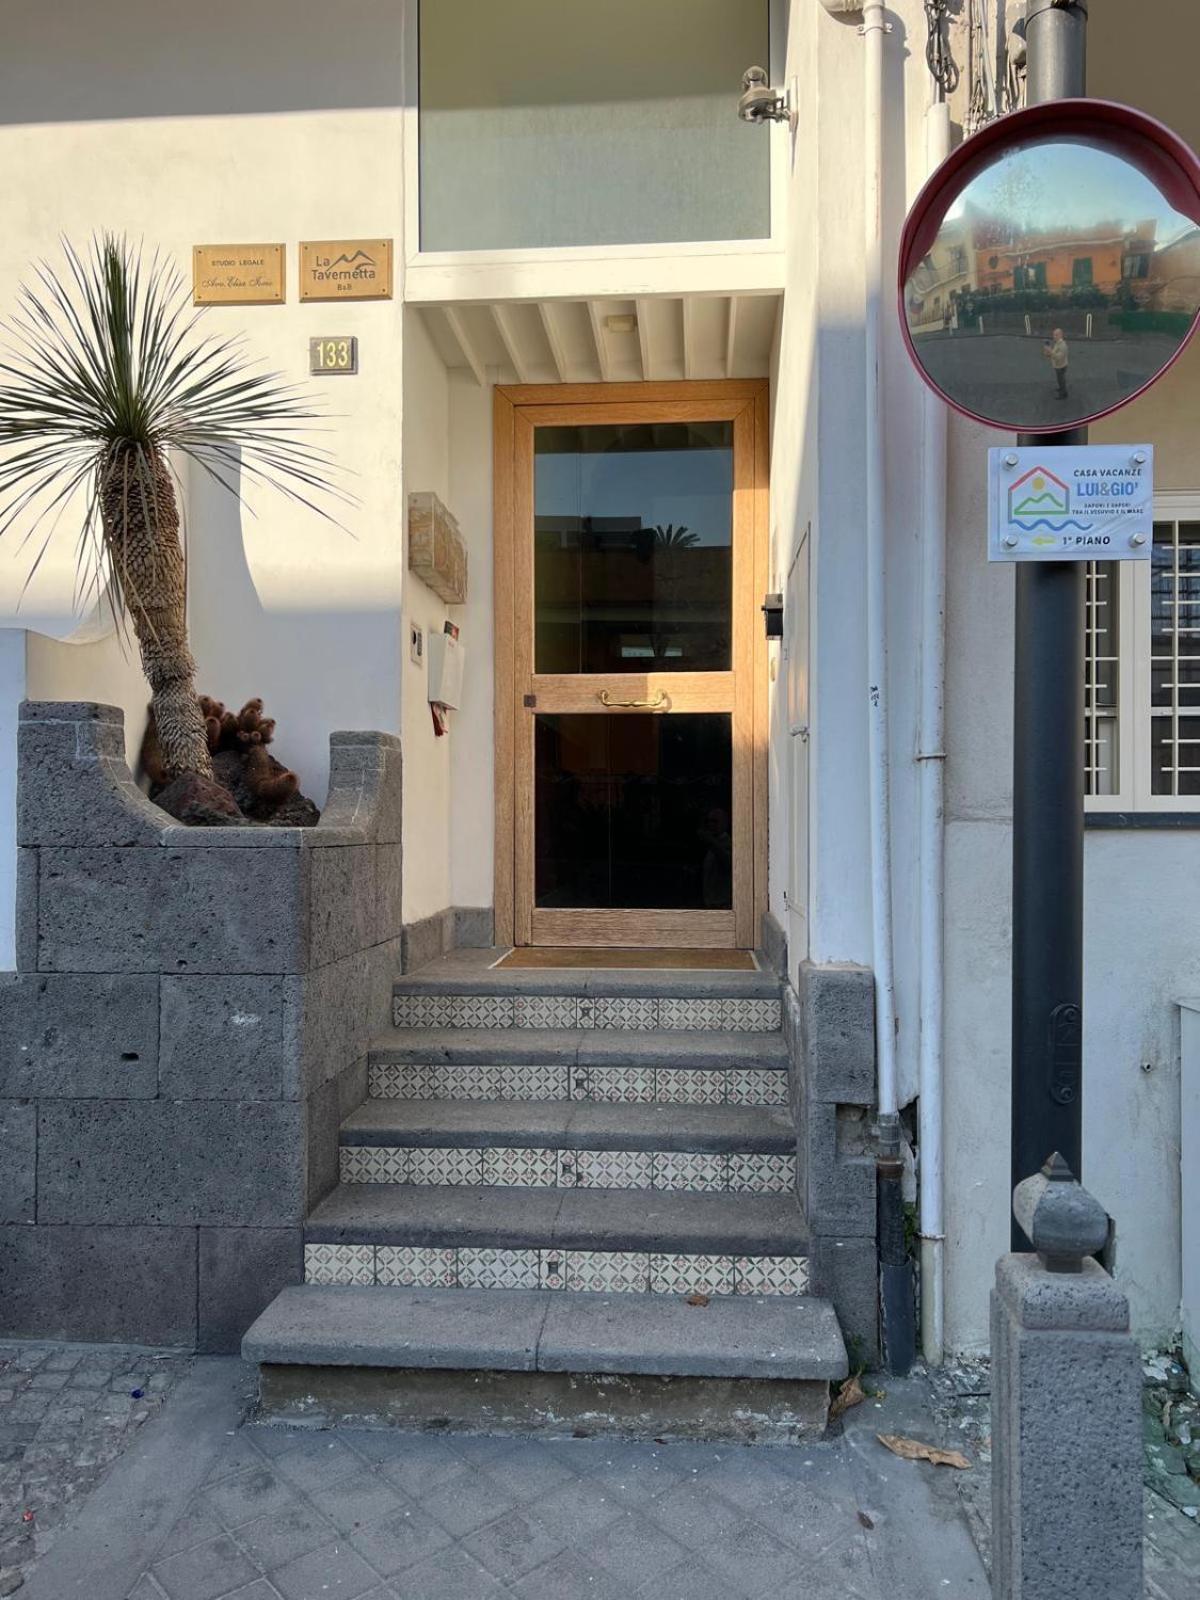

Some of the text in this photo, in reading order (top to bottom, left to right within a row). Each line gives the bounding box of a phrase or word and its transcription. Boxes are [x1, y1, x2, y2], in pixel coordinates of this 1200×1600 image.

[316, 255, 330, 267] La
[311, 268, 376, 280] Tavernetta
[317, 341, 348, 367] 133
[1073, 468, 1142, 477] CASA VACANZE
[1077, 481, 1138, 497] LUI&GIO'
[1075, 536, 1111, 545] PIANO
